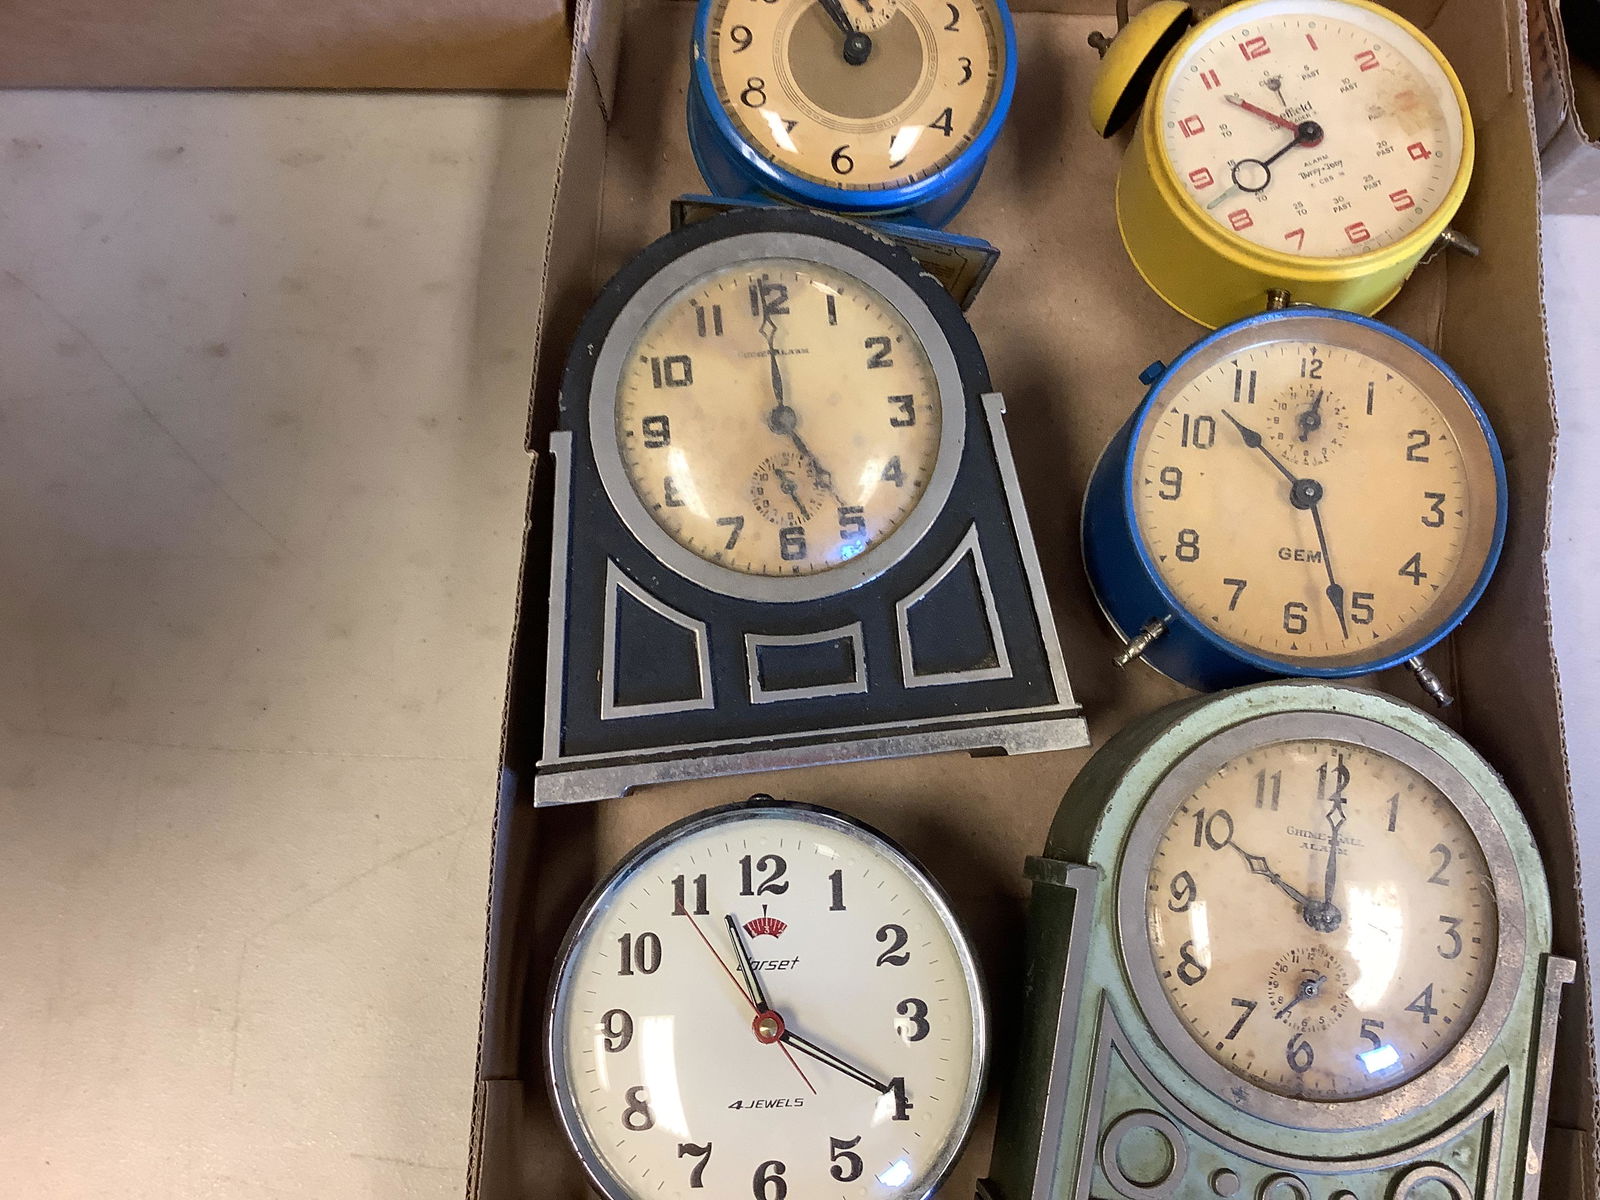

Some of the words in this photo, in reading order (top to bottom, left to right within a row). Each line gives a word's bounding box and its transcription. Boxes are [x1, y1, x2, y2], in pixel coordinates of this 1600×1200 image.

[944, 3, 960, 32] 2
[730, 25, 753, 53] 9
[1238, 36, 1271, 61] 12
[1305, 33, 1319, 51] 1
[957, 56, 973, 86] 3
[1300, 69, 1320, 80] PAST
[1354, 50, 1380, 72] 2
[740, 77, 767, 108] 8
[1199, 69, 1222, 90] 11
[1340, 82, 1359, 93] PAST
[929, 107, 954, 137] 4
[1177, 114, 1205, 138] 10
[831, 145, 855, 174] 6
[1376, 140, 1388, 149] 20
[1376, 146, 1395, 157] PAST
[1407, 142, 1432, 161] 4
[1188, 167, 1214, 190] 9
[1363, 174, 1374, 183] 25
[1363, 180, 1382, 191] PAST
[1297, 208, 1308, 217] TO
[1333, 195, 1345, 205] 30
[1333, 202, 1352, 213] PAST
[1389, 188, 1415, 211] 5
[1227, 208, 1254, 231] 8
[1344, 221, 1371, 244] 6
[1284, 228, 1305, 250] 7
[749, 283, 790, 317] 12
[826, 294, 838, 326] 1
[695, 304, 724, 337] 11
[864, 336, 893, 369] 2
[1301, 358, 1323, 380] 12
[650, 354, 693, 389] 10
[1234, 368, 1257, 404] 11
[887, 394, 916, 427] 3
[1367, 381, 1375, 415] 1
[642, 415, 671, 448] 9
[1181, 413, 1217, 450] 10
[1406, 429, 1431, 463] 2
[882, 455, 907, 487] 4
[1159, 466, 1183, 501] 9
[837, 505, 867, 540] 5
[1421, 491, 1446, 528] 3
[716, 515, 744, 549] 7
[779, 526, 807, 560] 6
[1175, 528, 1200, 563] 8
[1278, 547, 1323, 563] GEM
[1399, 552, 1427, 586] 4
[1223, 578, 1247, 611] 7
[1351, 592, 1375, 625] 5
[1283, 602, 1308, 635] 6
[1254, 768, 1282, 811] 11
[1191, 807, 1234, 851] 10
[1386, 793, 1400, 832] 1
[739, 854, 789, 896] 12
[1427, 843, 1452, 886] 2
[671, 874, 710, 916] 11
[828, 869, 847, 912] 1
[1168, 870, 1197, 913] 9
[617, 932, 662, 976] 10
[875, 924, 911, 967] 2
[1437, 915, 1463, 960] 3
[1176, 940, 1208, 986] 8
[896, 997, 931, 1042] 3
[1226, 997, 1258, 1040] 7
[1404, 983, 1438, 1024] 4
[600, 1008, 633, 1053] 9
[1286, 1033, 1315, 1073] 6
[621, 1085, 656, 1131] 8
[744, 1097, 804, 1109] JEWELS
[677, 1142, 712, 1188] 7
[829, 1135, 864, 1182] 5
[752, 1159, 788, 1200] 6
